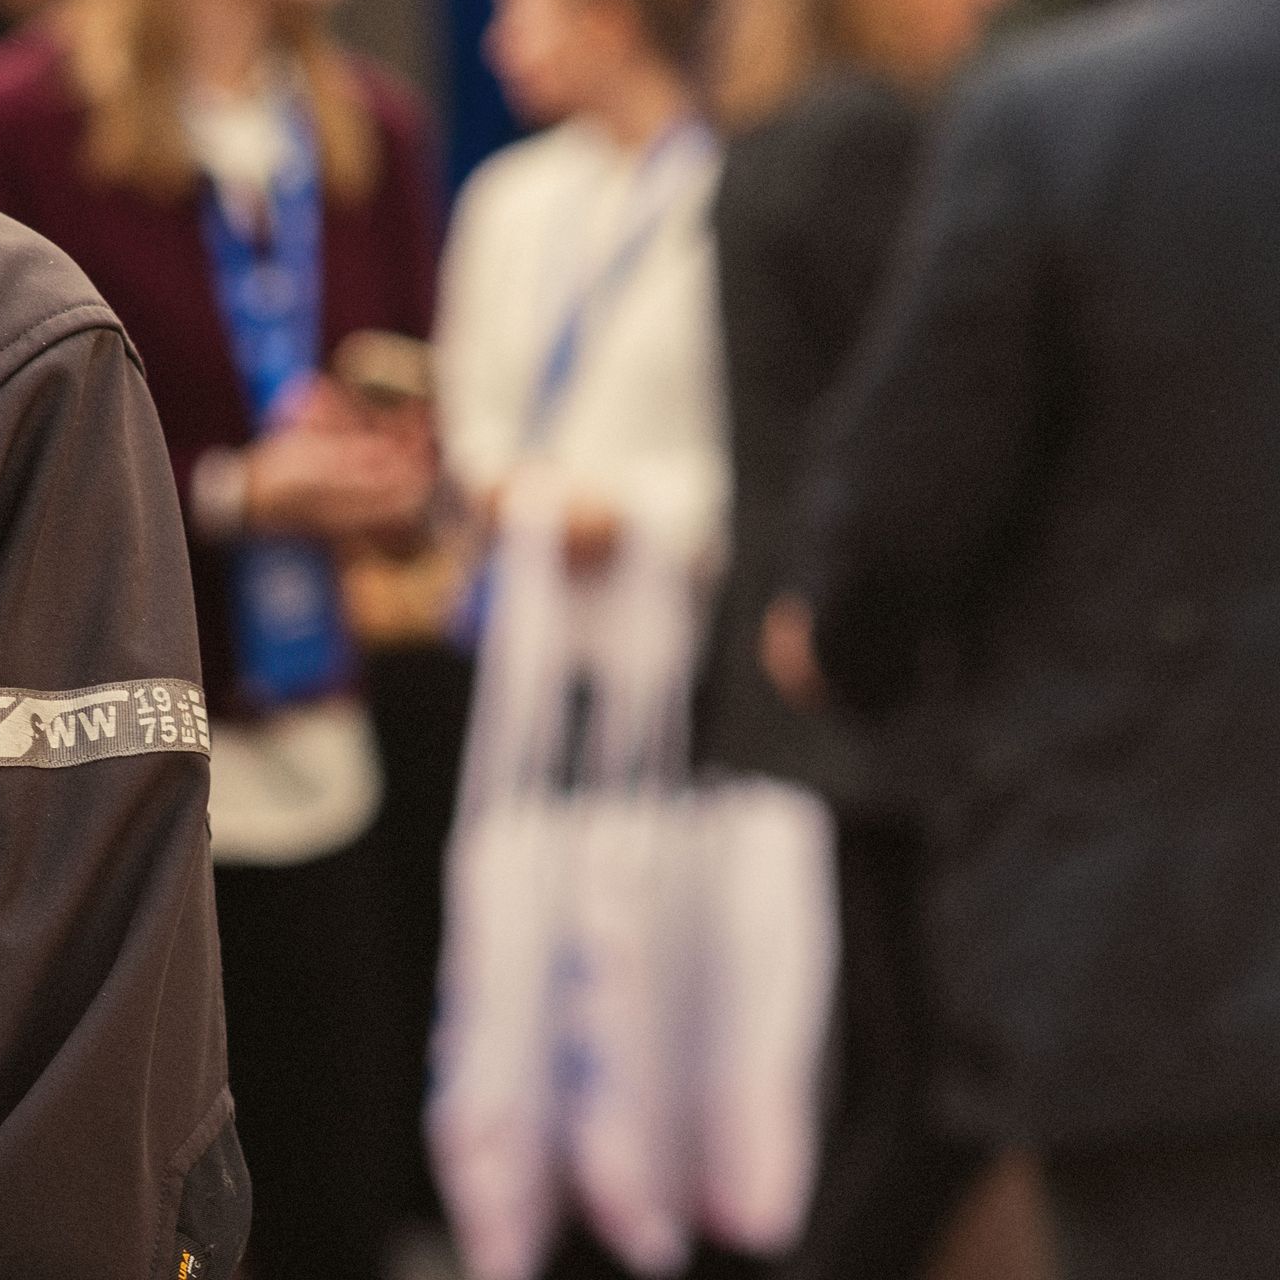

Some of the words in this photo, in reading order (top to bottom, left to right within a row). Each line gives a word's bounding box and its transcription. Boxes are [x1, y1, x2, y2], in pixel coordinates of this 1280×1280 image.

[133, 686, 172, 714] 19
[139, 715, 178, 744] 75
[178, 1252, 190, 1280] URA
